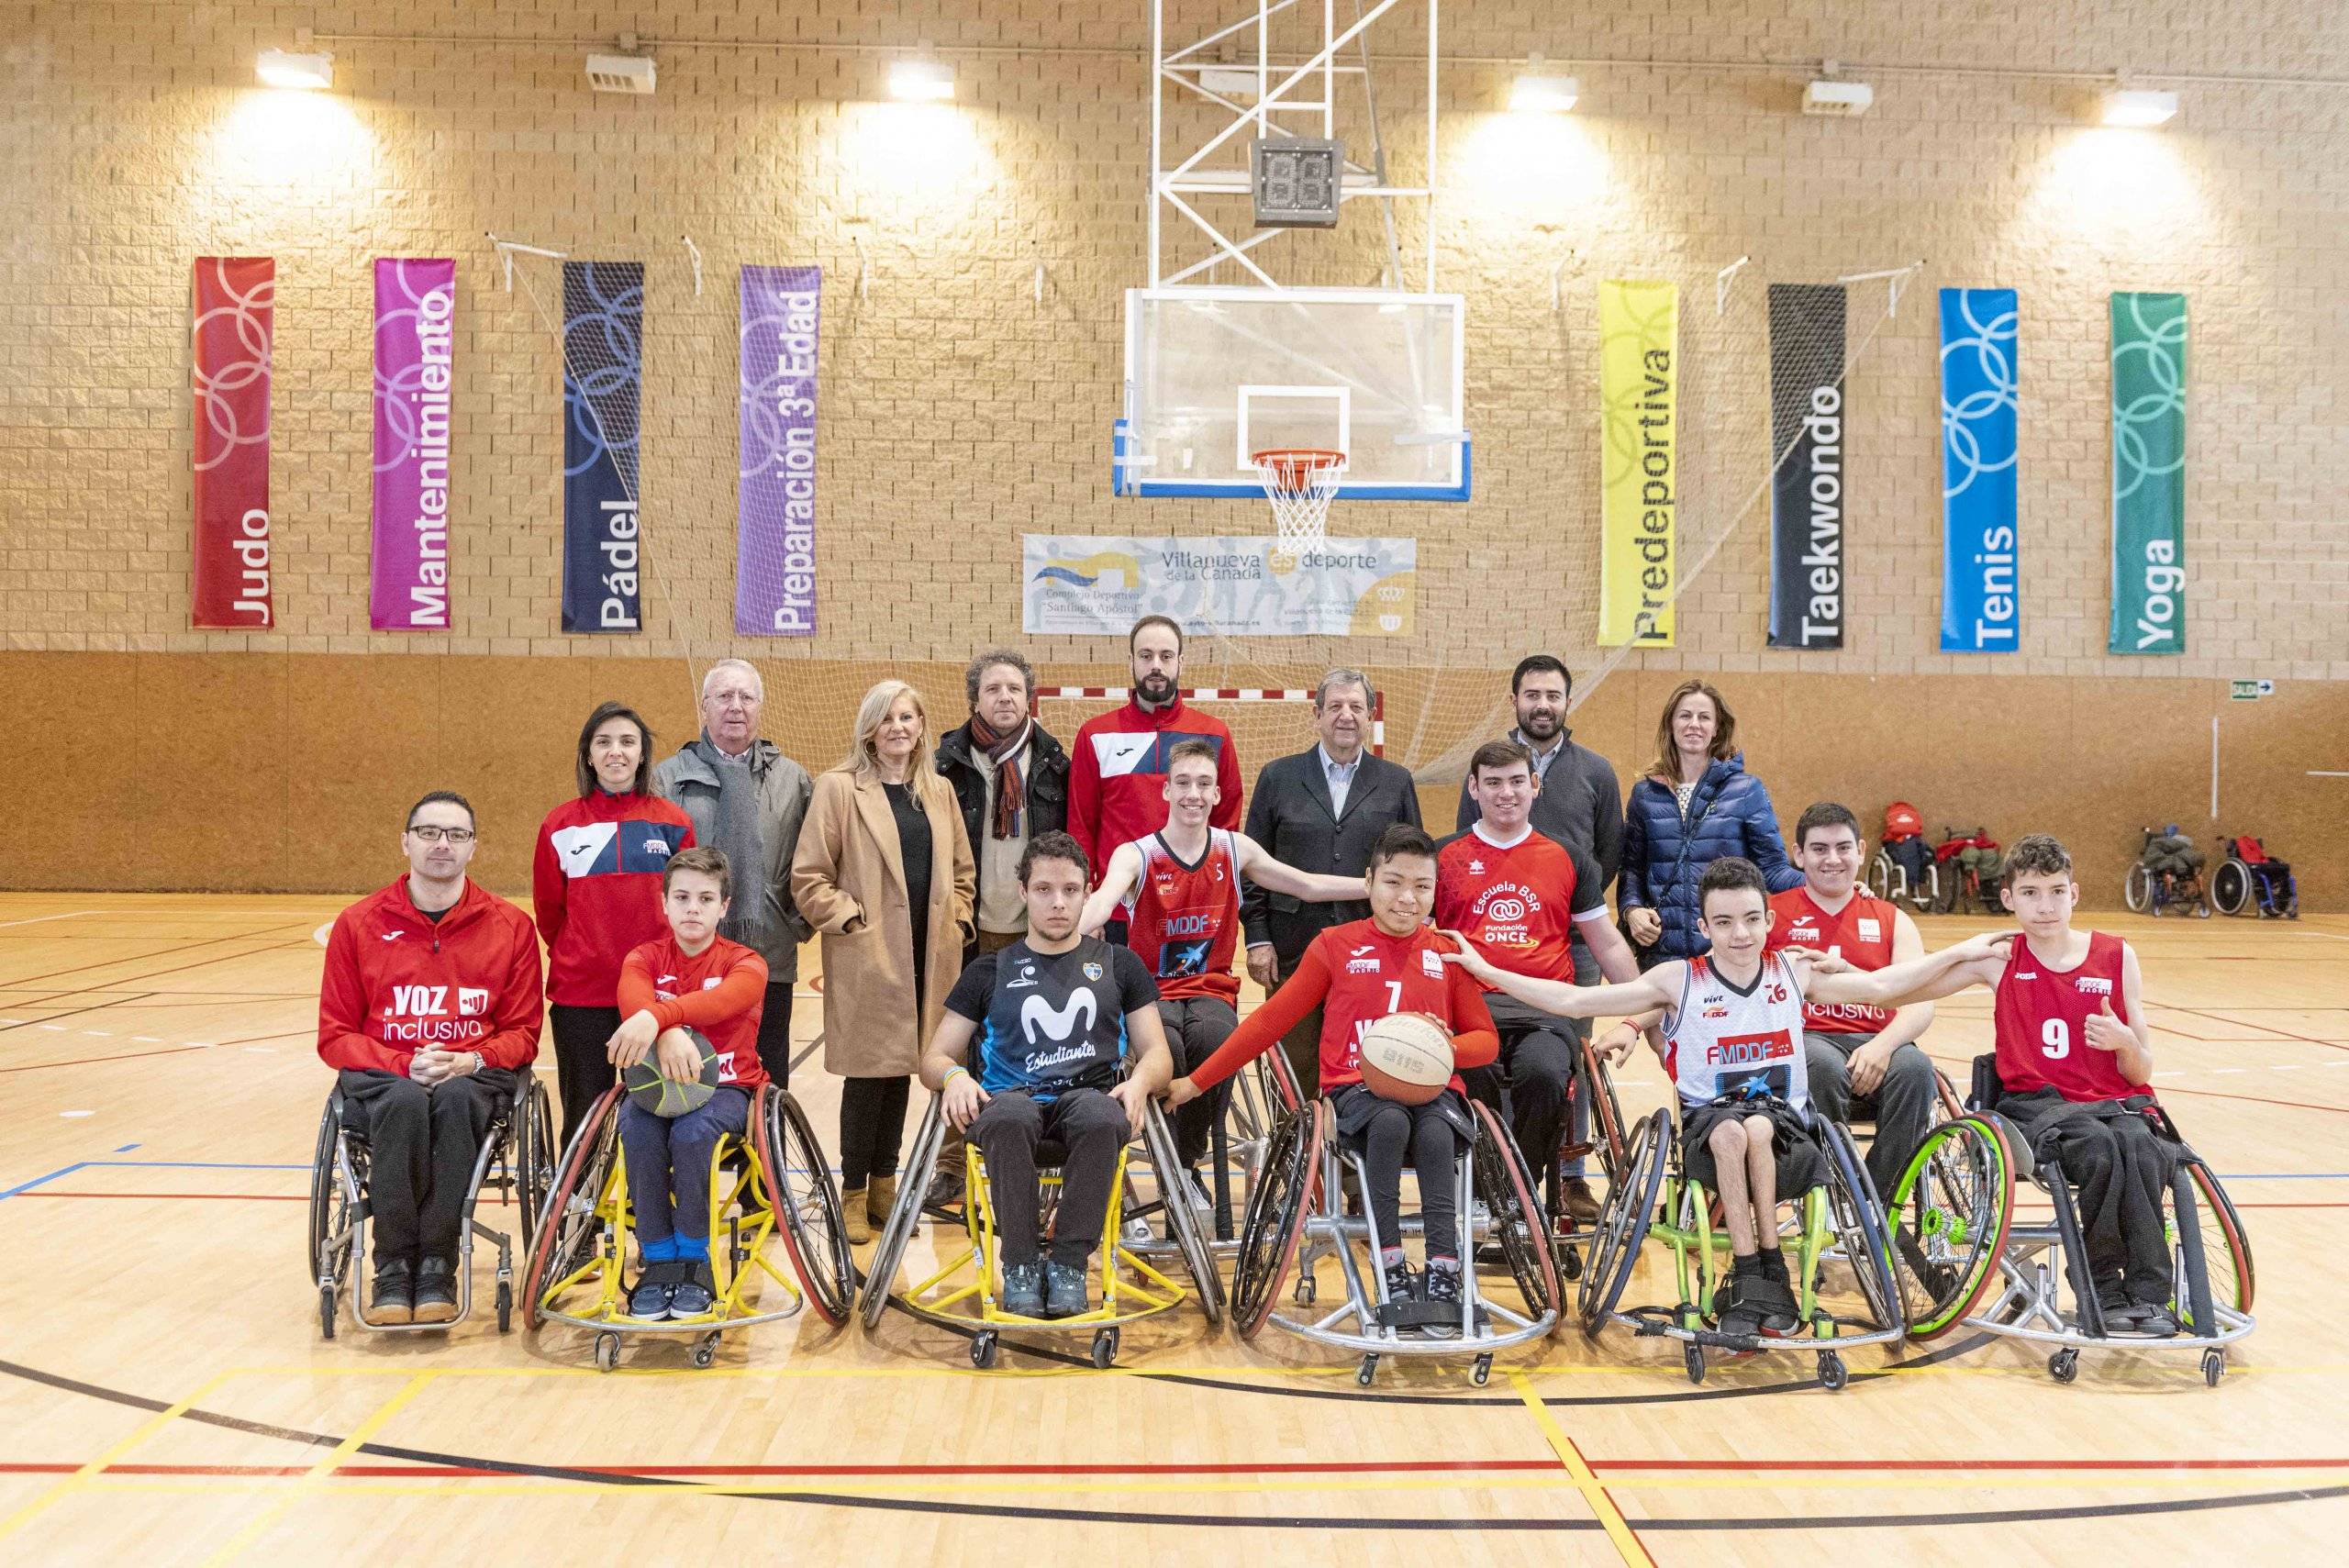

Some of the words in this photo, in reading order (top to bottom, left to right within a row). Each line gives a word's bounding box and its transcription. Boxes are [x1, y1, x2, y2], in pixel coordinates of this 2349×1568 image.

[778, 291, 818, 377] Edad
[410, 290, 451, 627] Mantenimiento
[1634, 349, 1675, 640] Predeportiva
[774, 424, 814, 632] Preparación
[1801, 384, 1841, 646] Taekwondo
[233, 507, 270, 626] Judo
[601, 500, 638, 628] Pádel
[1163, 552, 1261, 568] Villanueva
[1302, 550, 1377, 571] deporte
[1976, 524, 2013, 648] Tenis
[2137, 539, 2185, 650] Yoga
[1216, 862, 1224, 882] 5
[1473, 880, 1516, 915] Escuela
[1518, 884, 1542, 913] BSR
[1485, 923, 1528, 931] Fundación
[1485, 932, 1528, 943] ONCE
[393, 984, 449, 1016] VOZ
[1385, 980, 1402, 1013] 7
[1704, 995, 1723, 1004] vive
[383, 1016, 484, 1040] inclusiva
[2042, 1018, 2070, 1060] 9
[1025, 1040, 1097, 1073] Estudiantes
[1707, 1040, 1774, 1064] FMDDF
